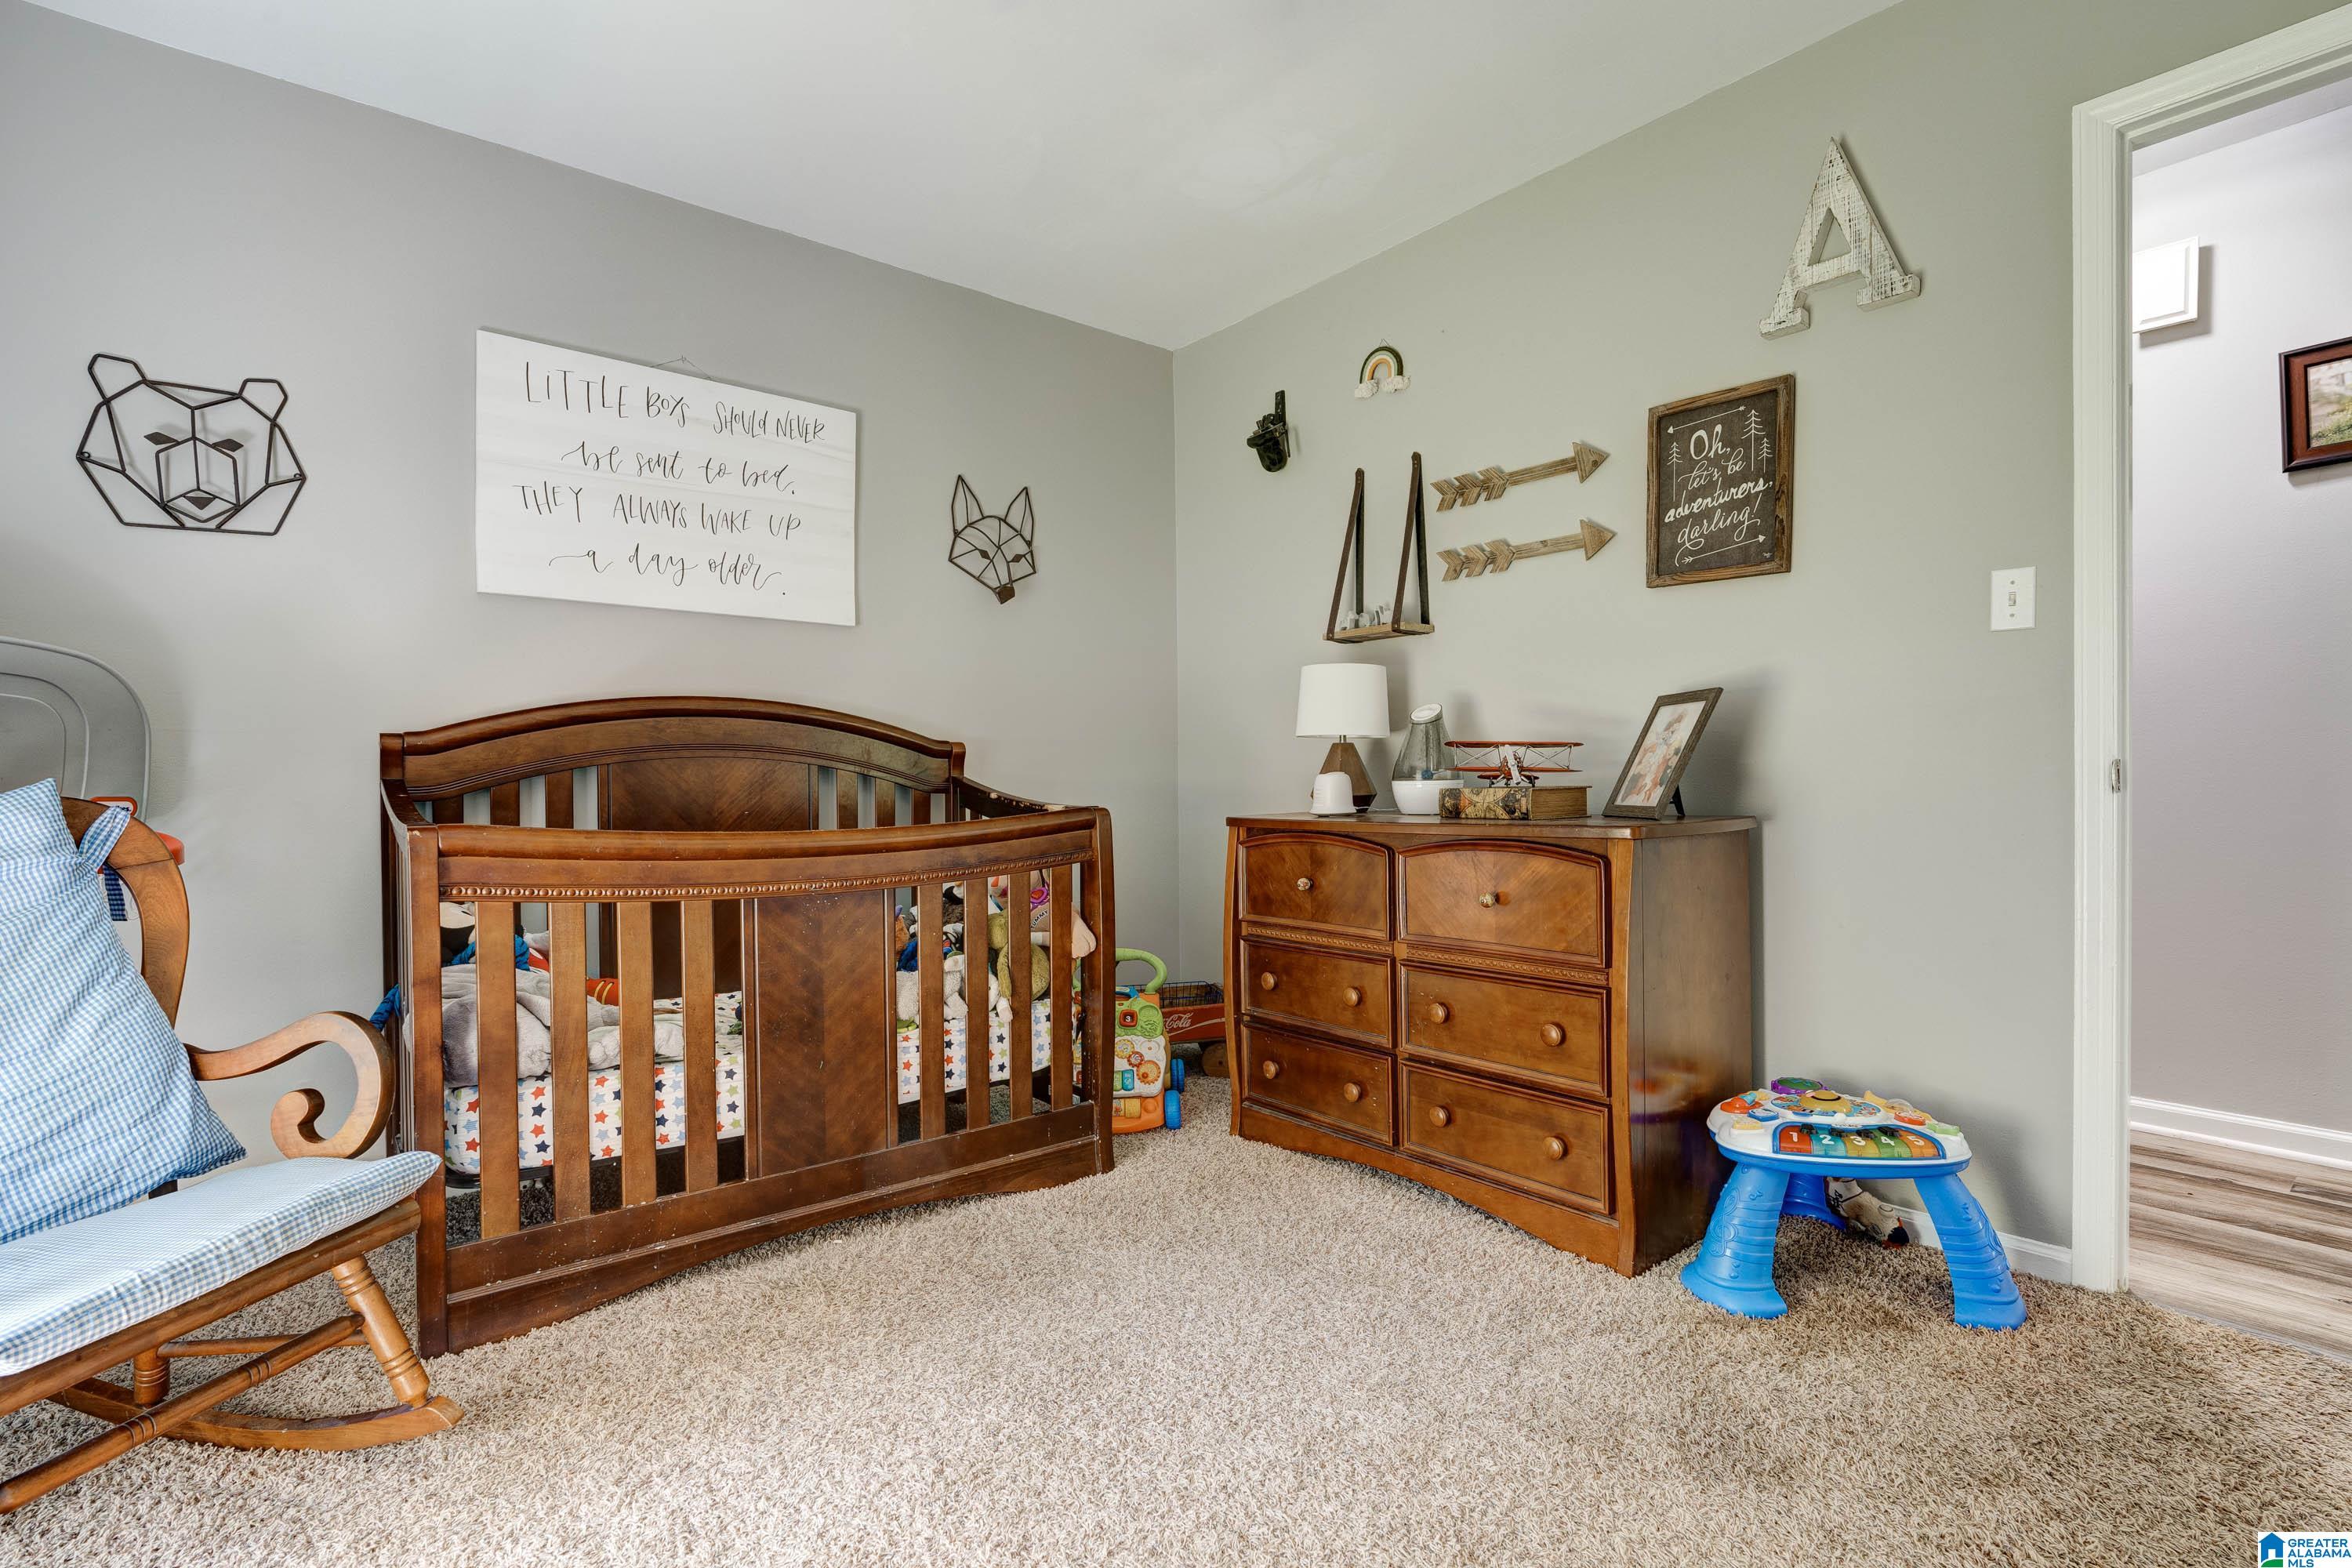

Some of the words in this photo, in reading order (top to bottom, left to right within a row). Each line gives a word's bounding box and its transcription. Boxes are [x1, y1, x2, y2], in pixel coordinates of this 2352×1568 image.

[1759, 136, 1921, 340] A
[646, 385, 691, 428] BOYS
[775, 410, 826, 444] NEVER
[1690, 423, 1731, 460] Oh,
[561, 441, 623, 474] be
[636, 450, 684, 480] sent
[697, 457, 733, 485] to
[742, 460, 796, 495] bed.
[1677, 460, 1722, 491] let's
[1721, 448, 1747, 475] be
[514, 480, 583, 524] THEY
[612, 493, 688, 529] ALWAYS
[701, 502, 752, 535] WAKE
[769, 513, 801, 540] UP
[1664, 477, 1774, 524] adventurers,
[1675, 492, 1762, 567] darling!
[628, 543, 699, 587] day
[708, 551, 787, 597] older.
[1165, 1012, 1193, 1030] Cola
[1789, 1131, 1798, 1142] 1
[1819, 1134, 1835, 1145] 2
[1849, 1135, 1867, 1146] 3
[1881, 1136, 1895, 1146] 4
[1906, 1135, 1926, 1146] 5
